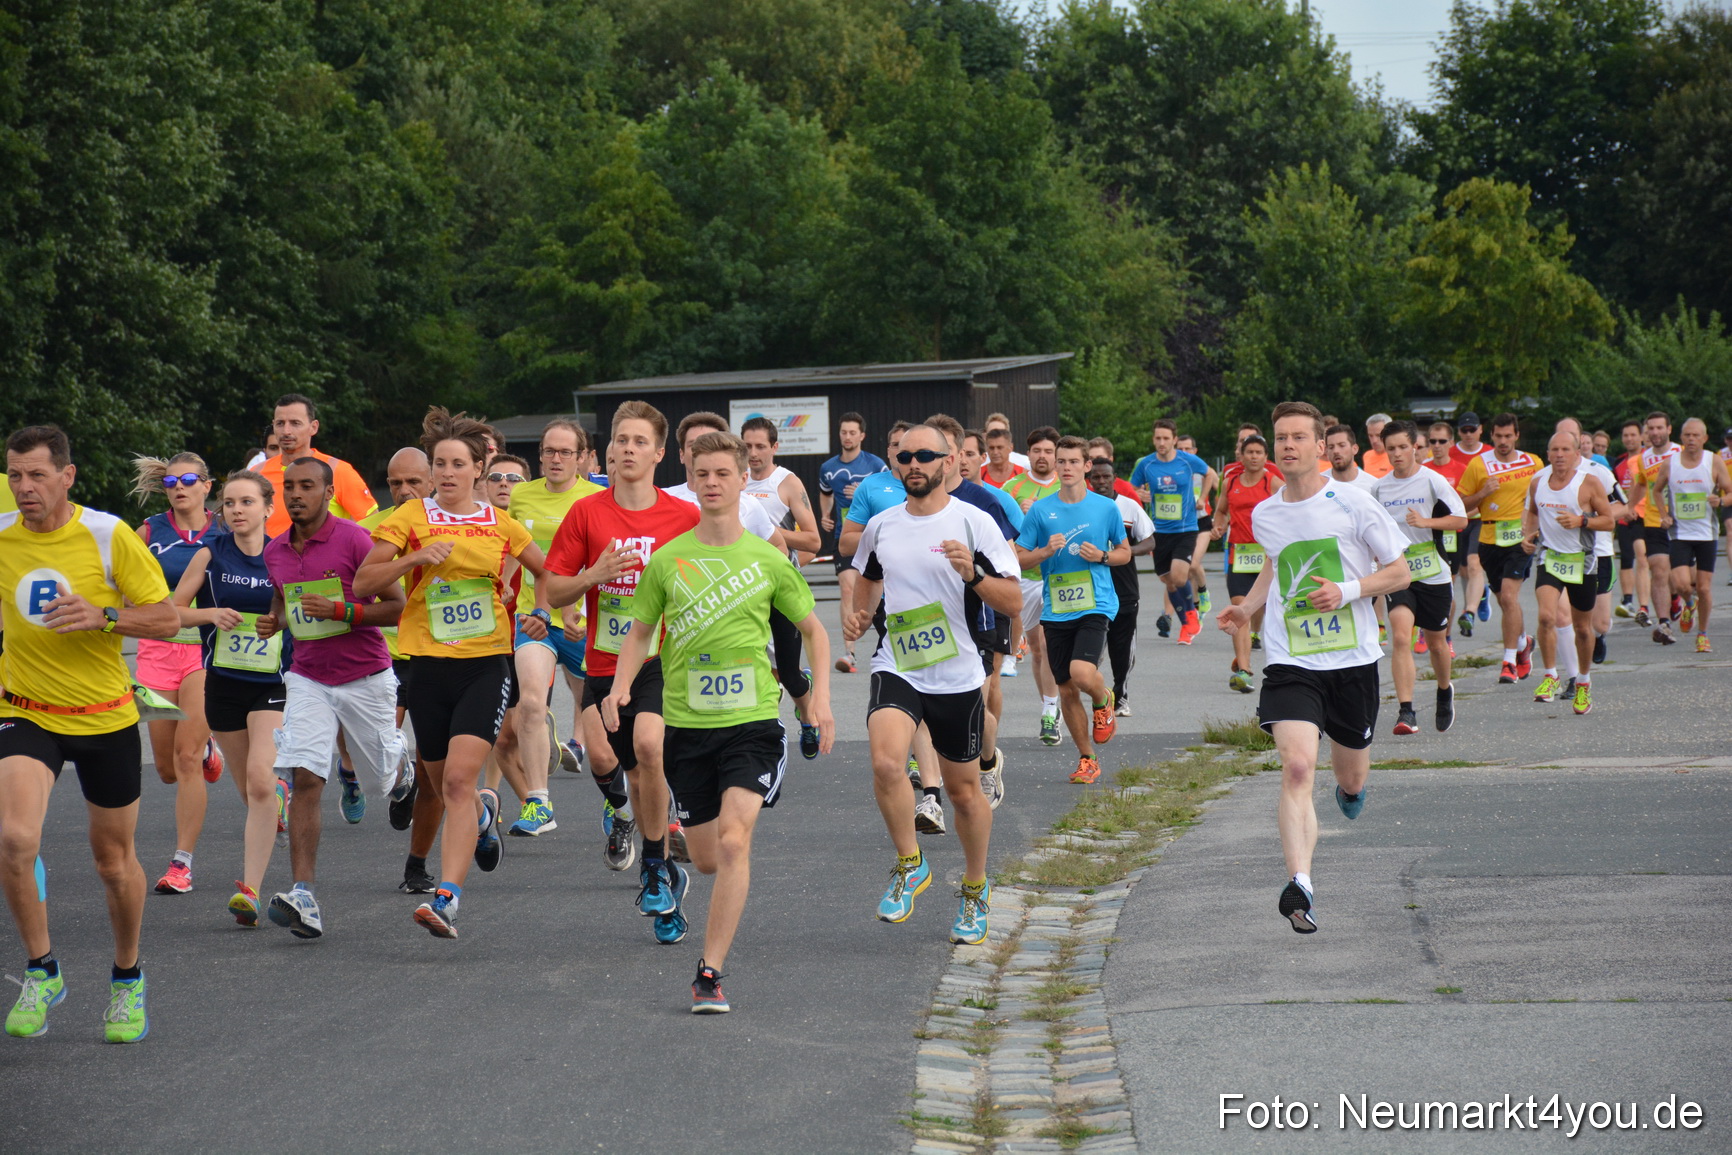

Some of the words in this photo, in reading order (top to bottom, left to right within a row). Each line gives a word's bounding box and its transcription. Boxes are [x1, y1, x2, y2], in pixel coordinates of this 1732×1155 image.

[1498, 475, 1512, 483] AX
[1159, 504, 1176, 513] 450
[1384, 498, 1425, 508] DELPHI
[1682, 503, 1700, 513] 591
[429, 527, 461, 536] MAX
[465, 526, 501, 538] BÖGL
[1237, 555, 1263, 565] 1366
[1552, 562, 1574, 576] 581
[221, 573, 250, 585] EURO
[29, 580, 62, 615] B
[668, 561, 763, 639] BURKHARDT
[1058, 587, 1085, 602] 822
[442, 601, 482, 624] 896
[675, 629, 699, 648] ENERGIE-
[699, 618, 714, 631] UND
[714, 579, 770, 620] GEBÄUDETECHNIK
[1300, 615, 1341, 638] 114
[228, 634, 269, 656] 372
[896, 626, 946, 655] 1439
[699, 673, 744, 696] 205
[493, 676, 511, 737] skinfit
